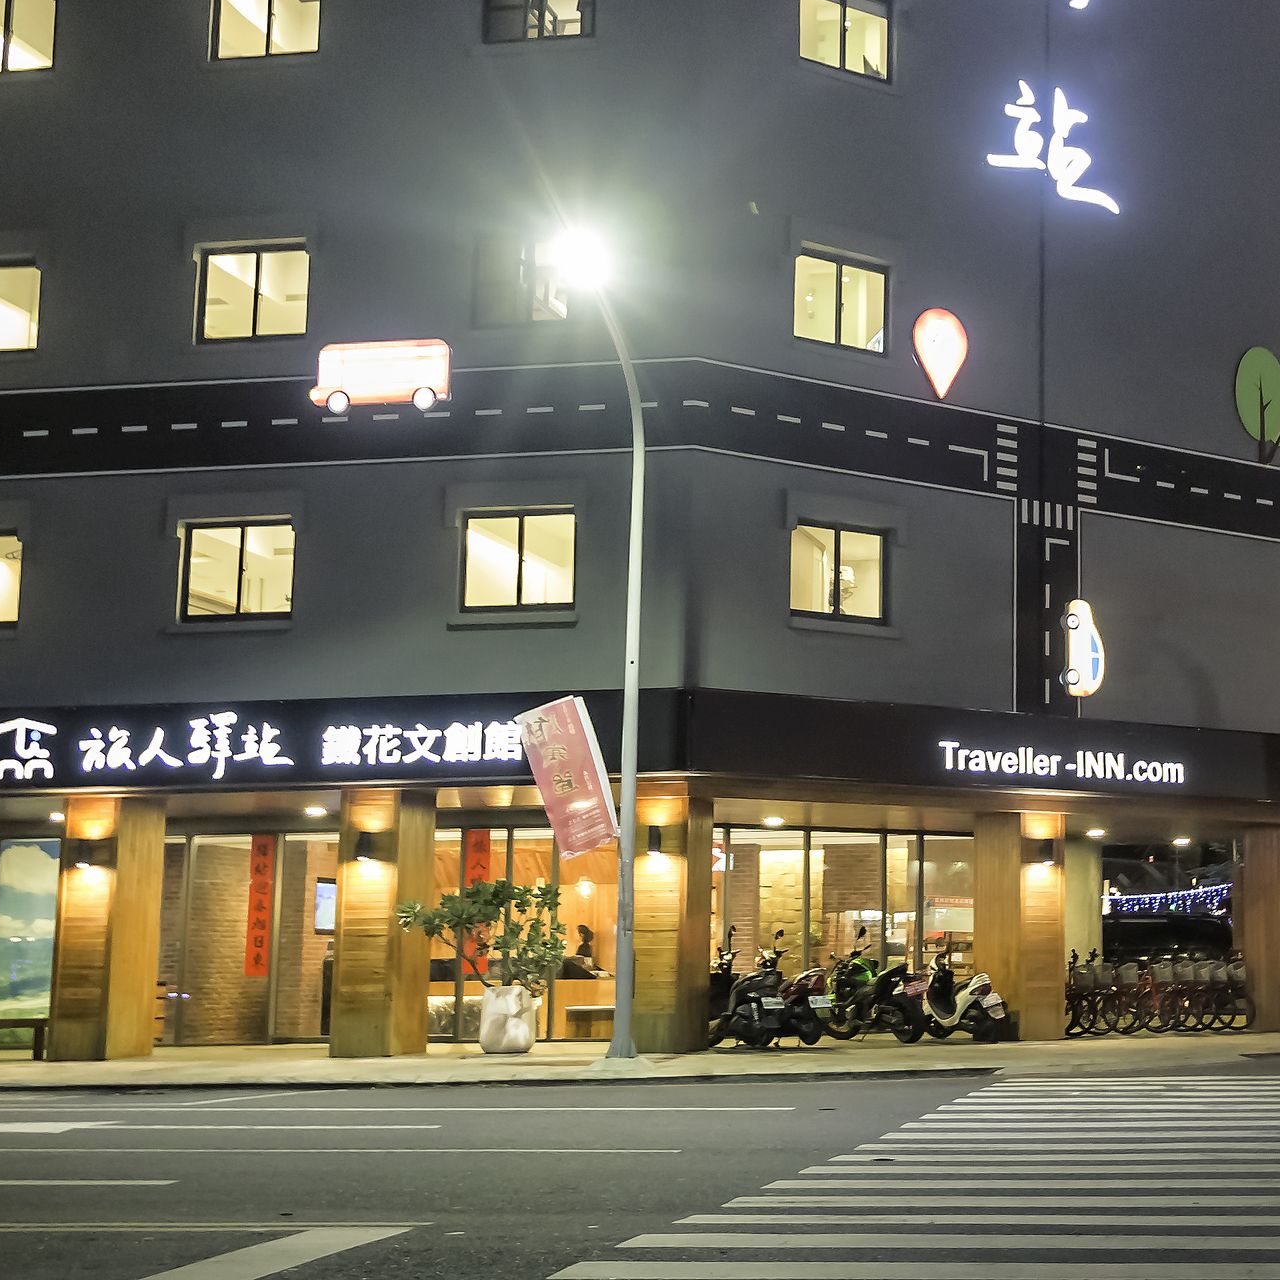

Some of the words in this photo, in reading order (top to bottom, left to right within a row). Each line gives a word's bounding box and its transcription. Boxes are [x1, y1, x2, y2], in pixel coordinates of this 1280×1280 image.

[78, 711, 295, 780] 旅人驛站
[321, 720, 522, 766] 鐵花文創館
